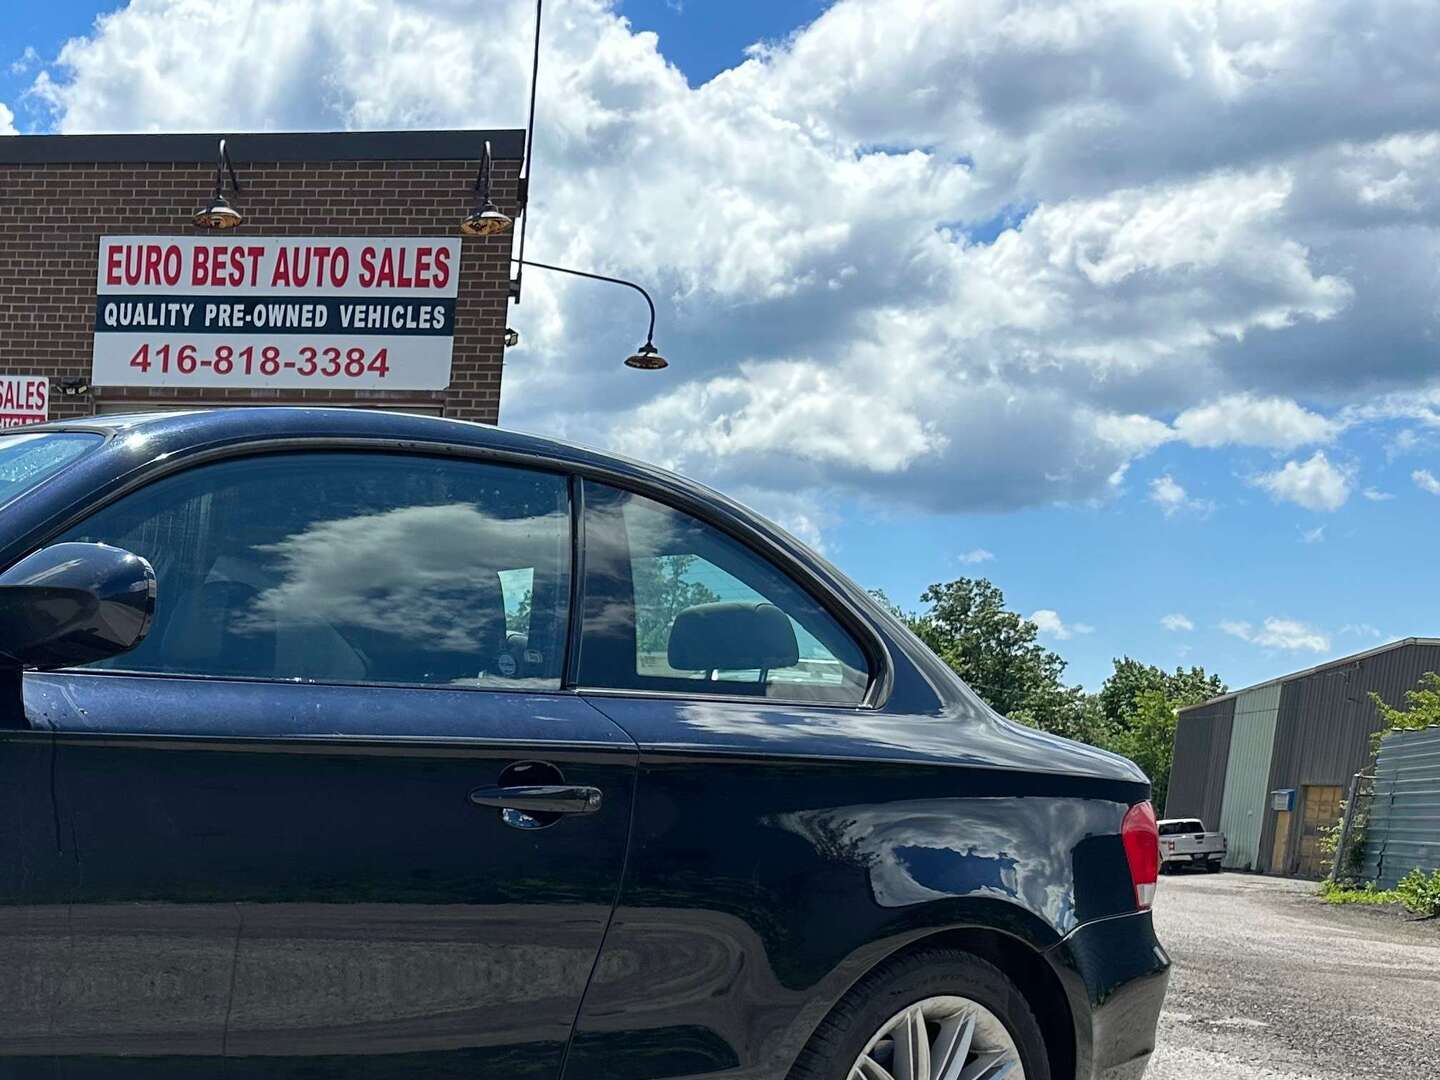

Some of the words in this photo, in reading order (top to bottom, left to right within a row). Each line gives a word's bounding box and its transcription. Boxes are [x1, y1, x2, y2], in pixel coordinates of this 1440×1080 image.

[106, 244, 182, 287] EURO
[191, 245, 265, 288] BEST
[271, 246, 350, 289] AUTO
[358, 246, 451, 289] SALES
[104, 302, 195, 328] QUALITY
[204, 303, 328, 328] PRE-OWNED
[339, 304, 446, 330] VEHICLES
[129, 343, 390, 378] 416-818-3384
